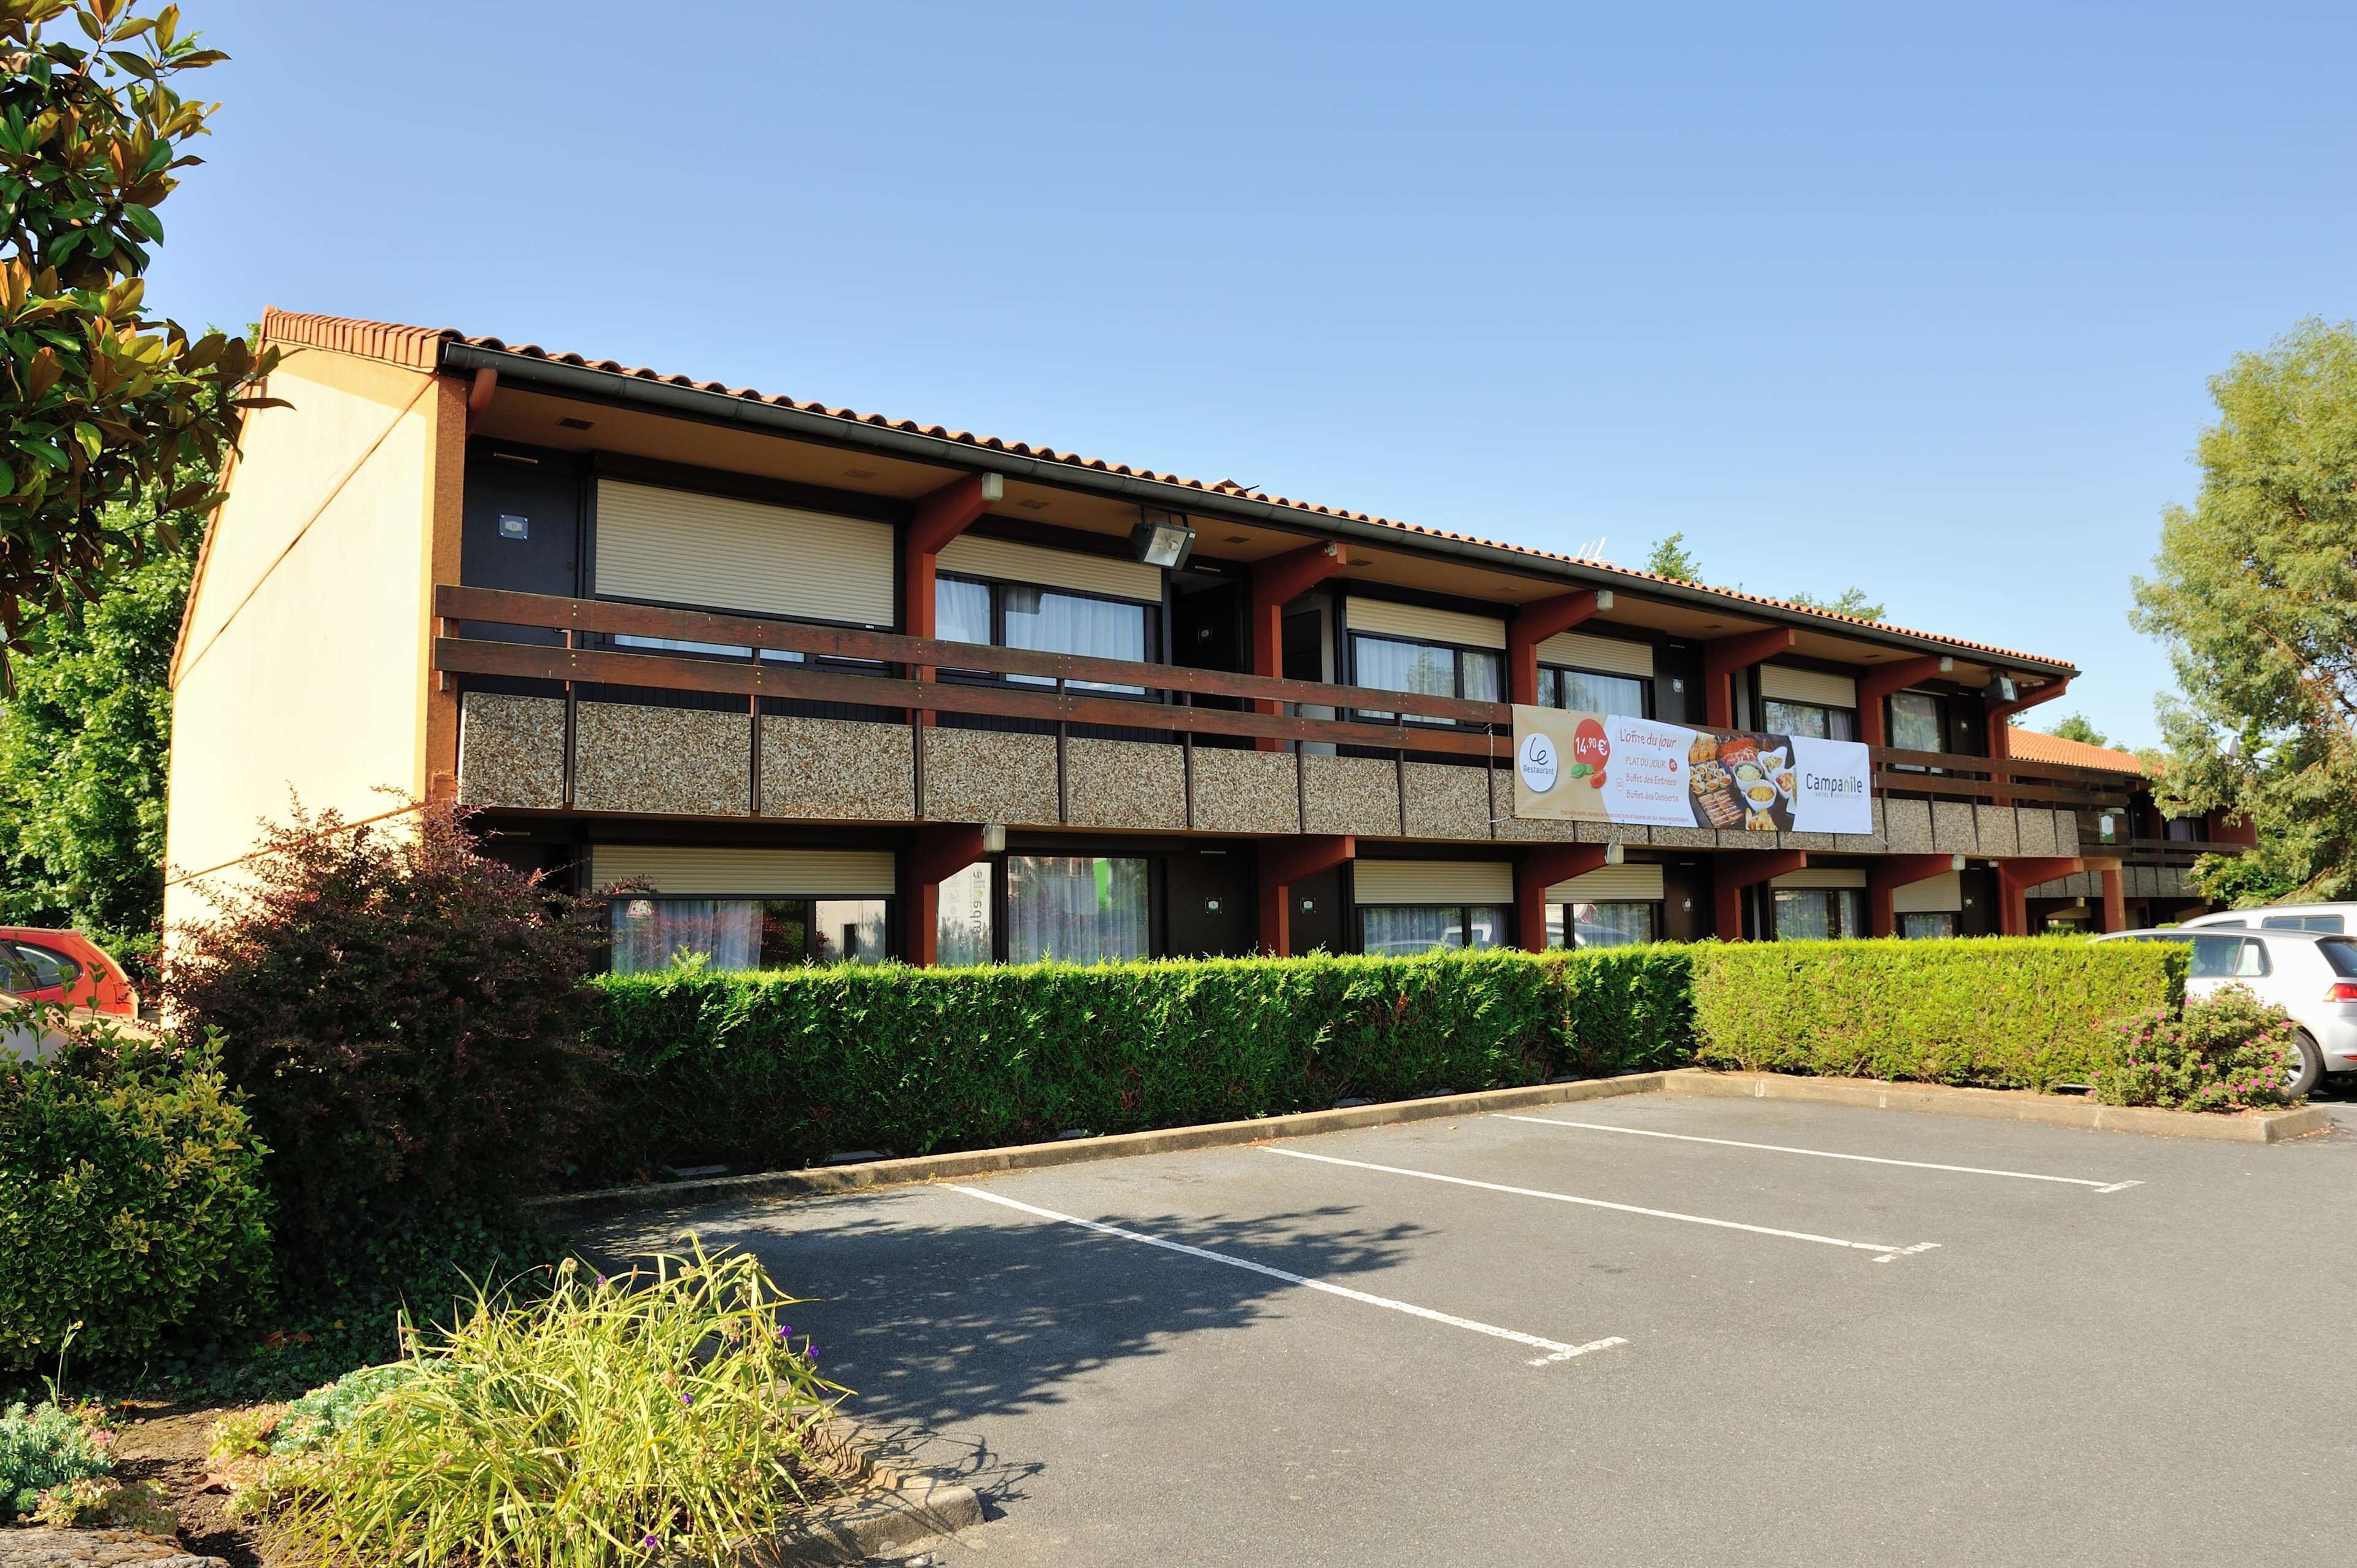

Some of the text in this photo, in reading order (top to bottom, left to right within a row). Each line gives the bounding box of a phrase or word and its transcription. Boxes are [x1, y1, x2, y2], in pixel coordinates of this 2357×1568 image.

[1620, 728, 1677, 751] L'offre du jour
[1625, 756, 1640, 766] PLAT
[1640, 757, 1649, 767] DU
[1523, 765, 1554, 775] Restaurant
[1626, 773, 1643, 783] Buffet
[1806, 773, 1863, 798] Campanile
[1626, 789, 1679, 803] Buffet des Desserts
